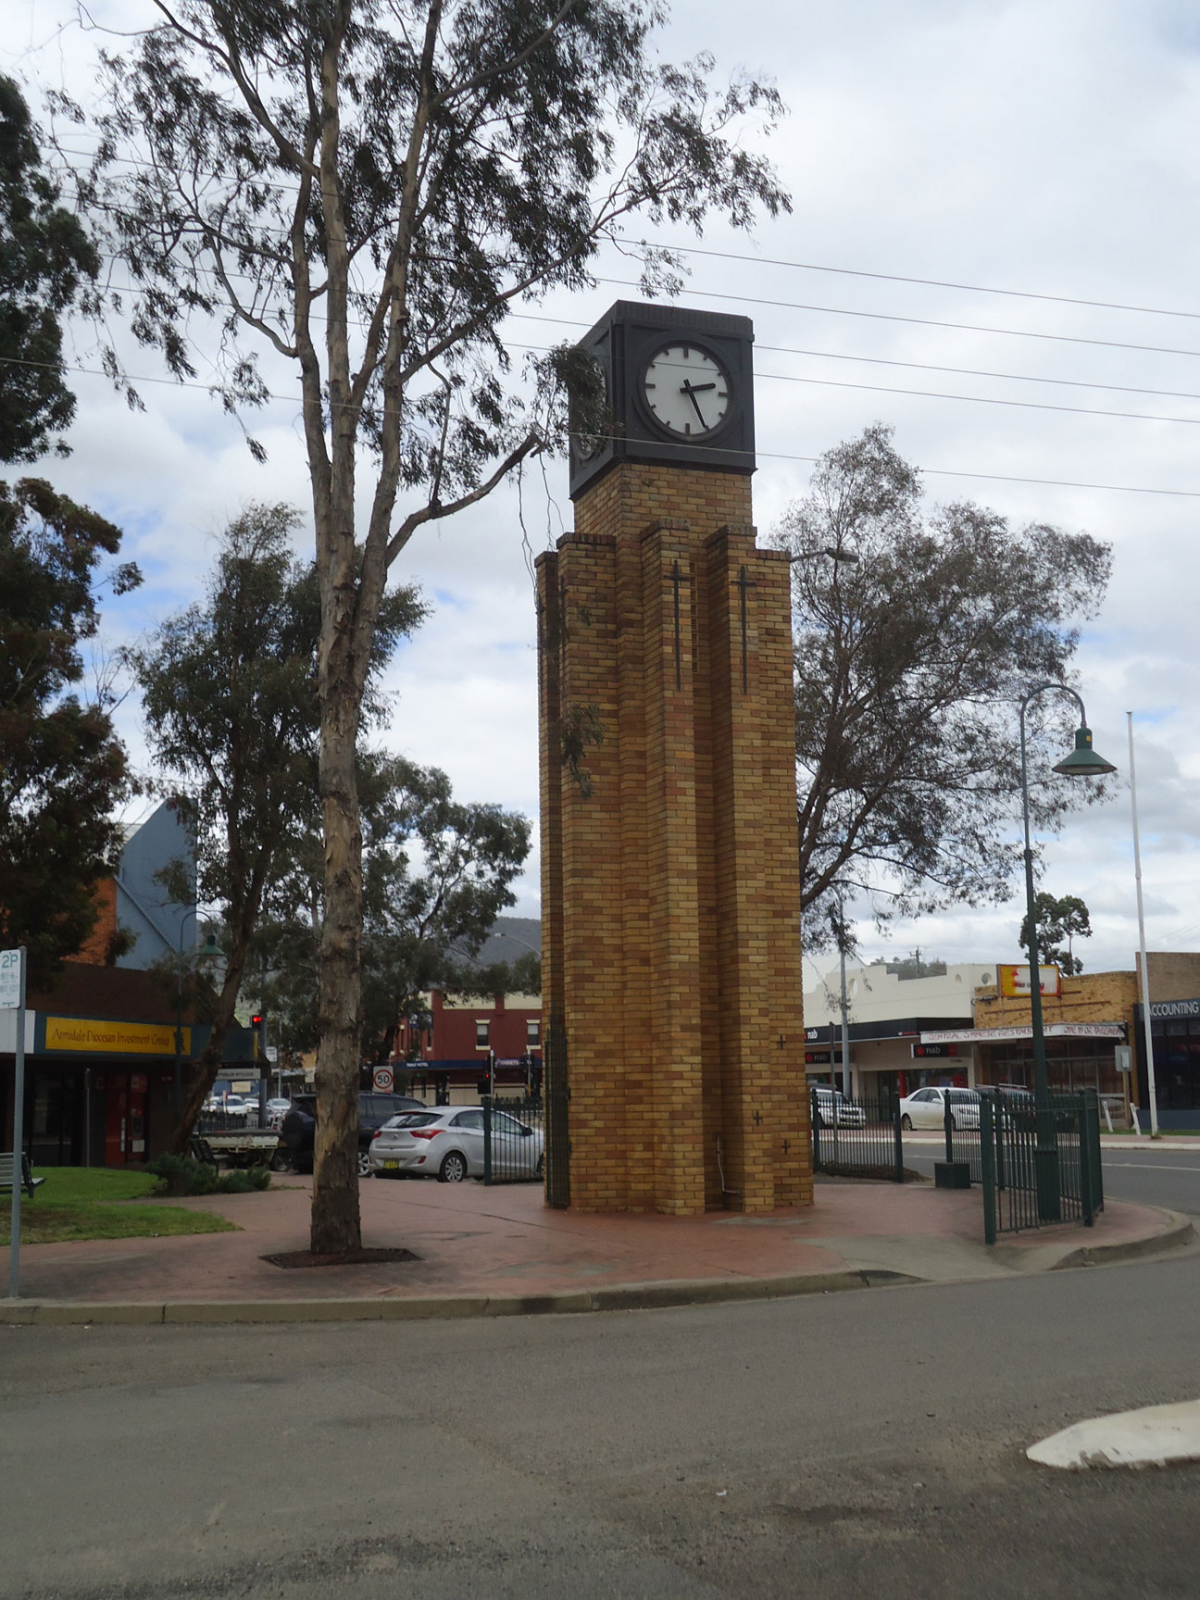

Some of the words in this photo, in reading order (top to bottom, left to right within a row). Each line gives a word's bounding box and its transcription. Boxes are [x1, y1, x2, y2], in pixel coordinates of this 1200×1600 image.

[2, 954, 18, 968] 2P
[1147, 1001, 1199, 1016] ACCOUNTING
[51, 1028, 85, 1042] Armidale
[86, 1029, 116, 1044] Diocesan
[117, 1031, 149, 1045] Investment
[807, 1029, 818, 1040] nab
[925, 1045, 941, 1055] nab
[377, 1074, 390, 1085] 50
